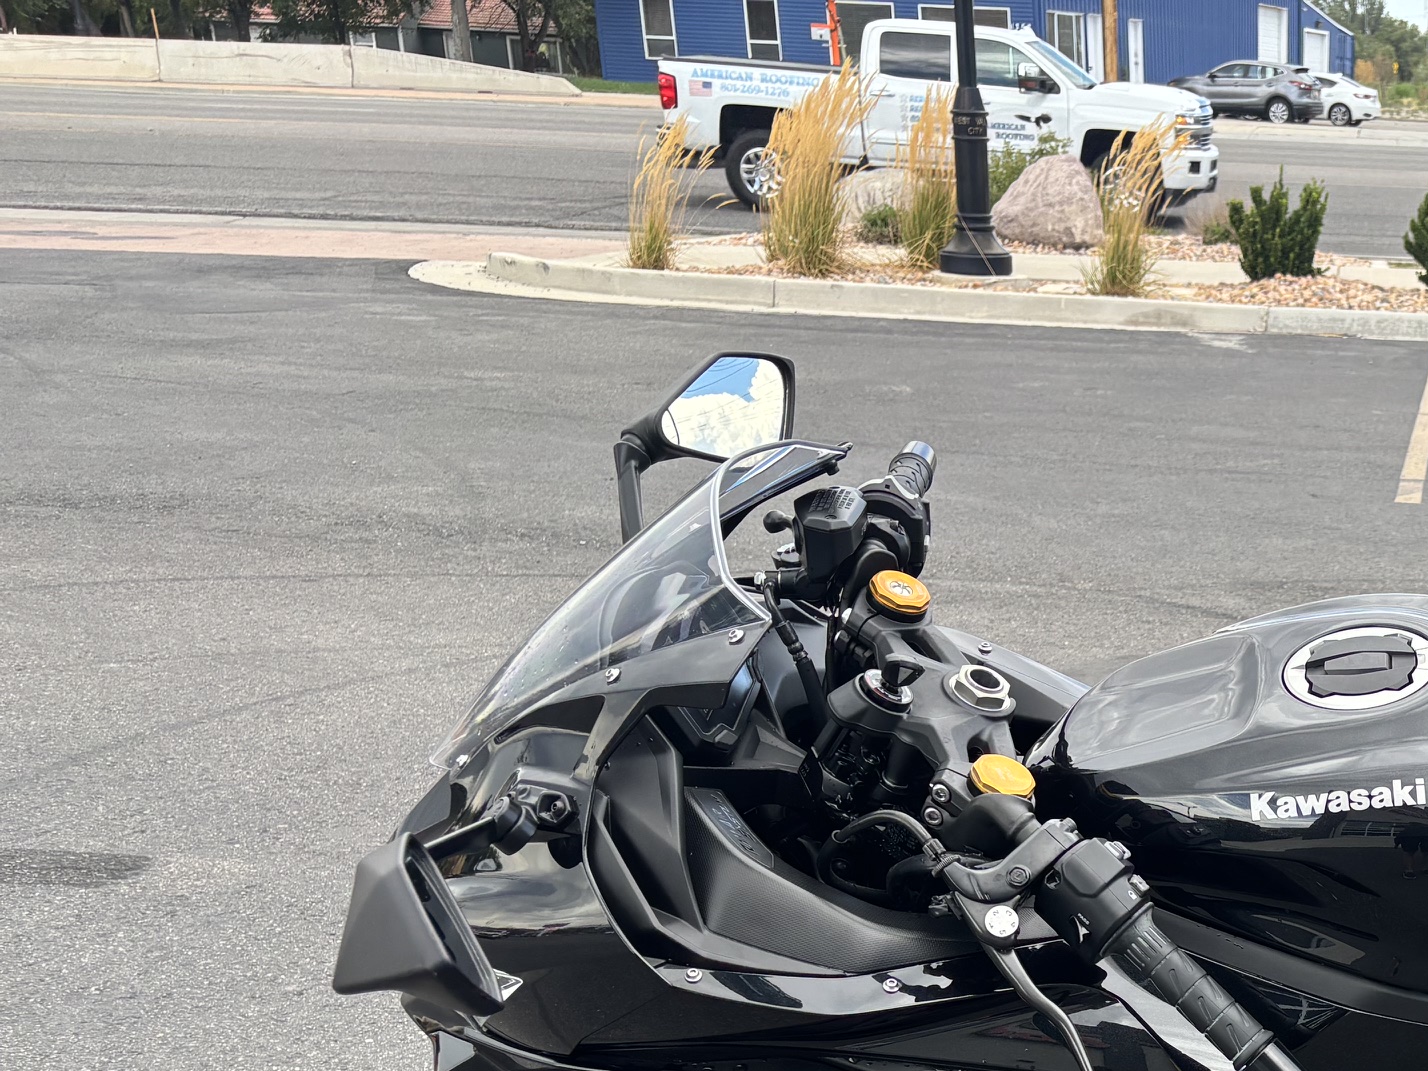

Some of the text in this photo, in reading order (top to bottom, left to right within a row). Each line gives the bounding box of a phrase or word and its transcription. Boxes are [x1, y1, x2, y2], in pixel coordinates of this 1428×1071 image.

[691, 67, 754, 82] AMERICAN
[720, 82, 790, 98] 801-269-1276
[988, 122, 1026, 131] MERICAN
[995, 131, 1035, 141] ROOFING
[1249, 777, 1427, 822] Kawasaki
